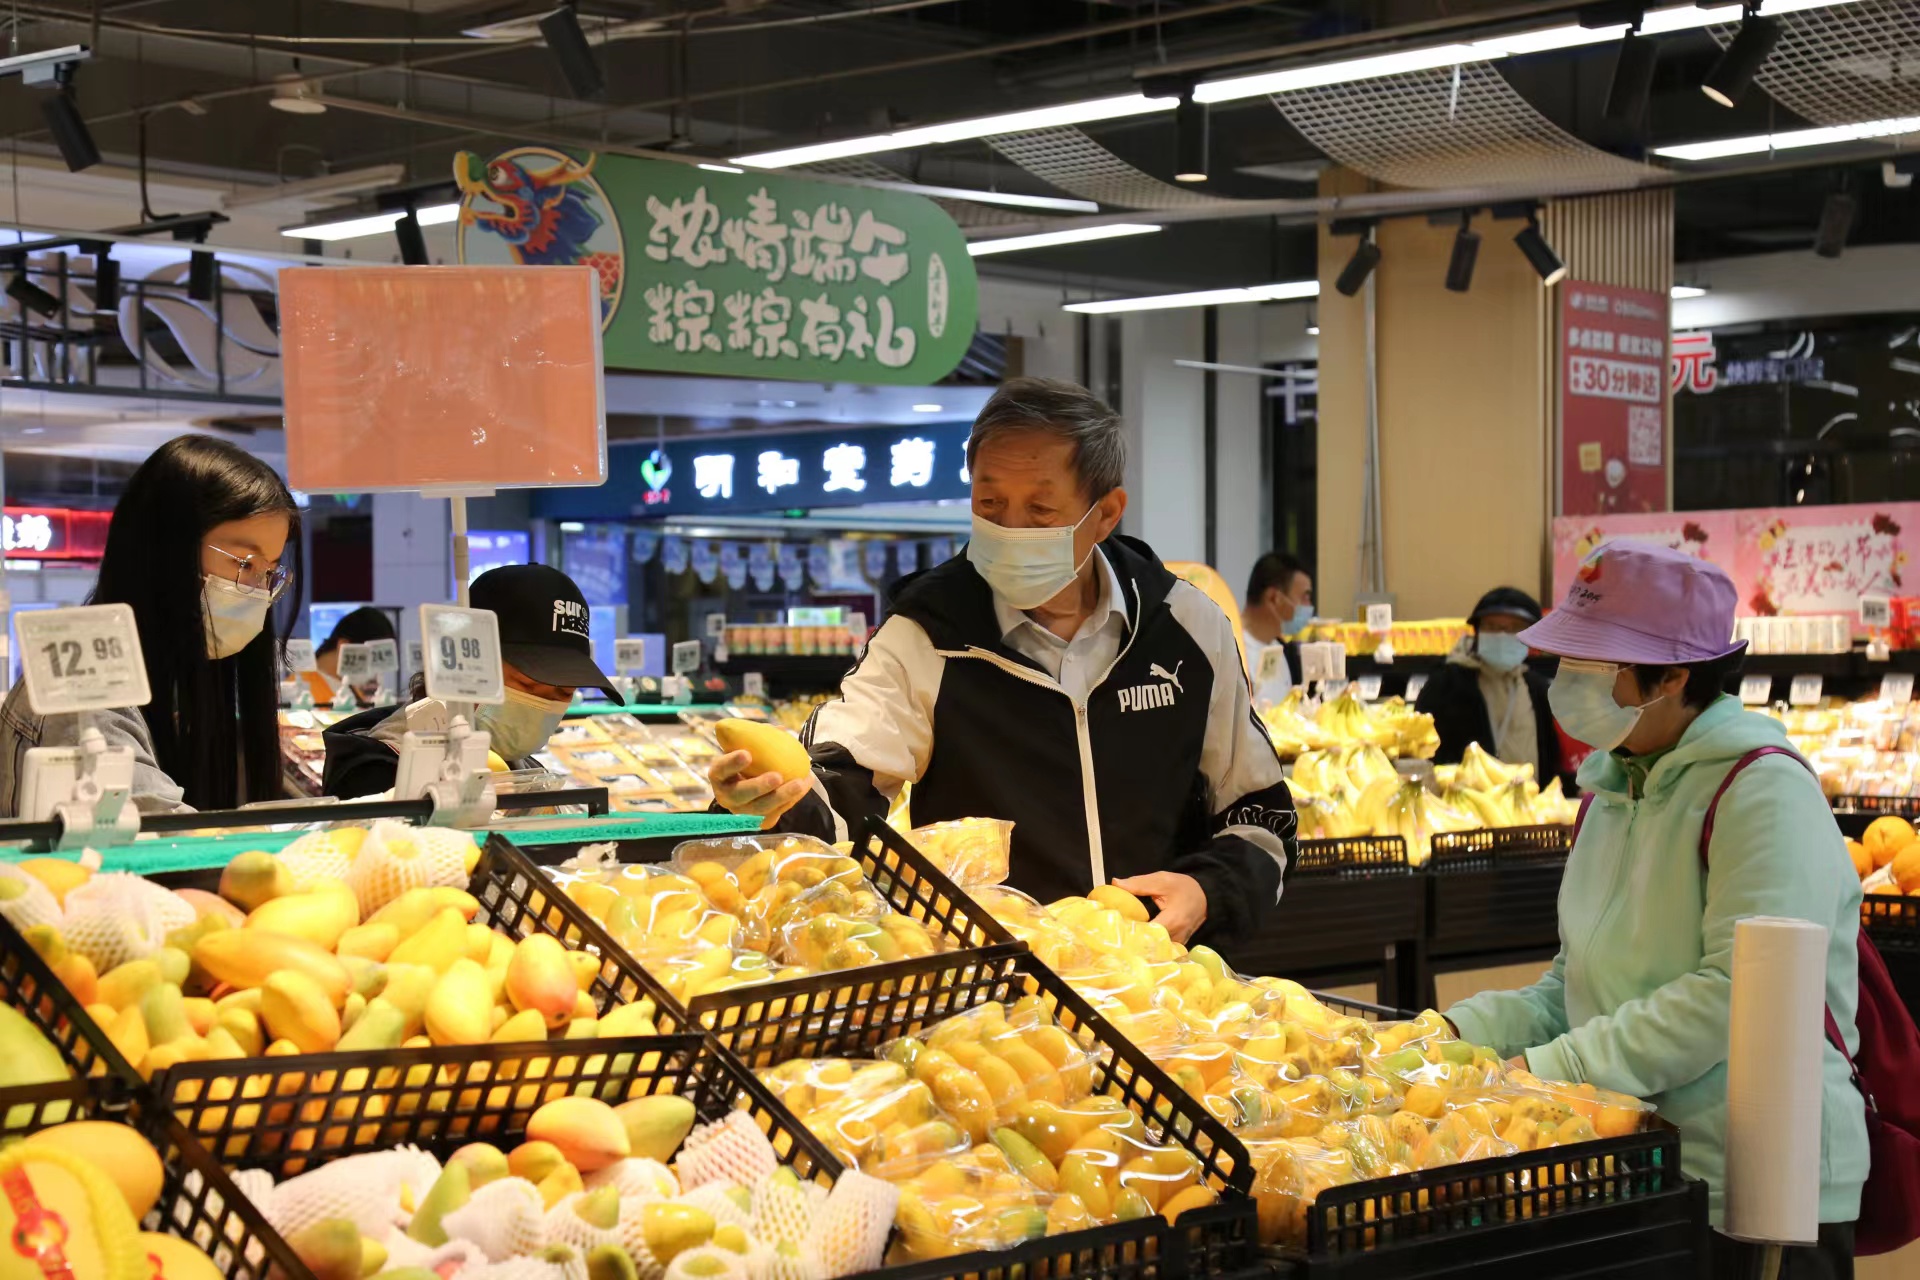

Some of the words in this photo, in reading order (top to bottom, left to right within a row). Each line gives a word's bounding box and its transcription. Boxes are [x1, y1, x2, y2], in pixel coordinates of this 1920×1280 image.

[645, 185, 909, 286] 浓情端午
[644, 280, 916, 367] 粽粽有礼
[42, 636, 123, 678] 12.98
[440, 635, 481, 671] 9.98
[1117, 682, 1175, 713] PUMA
